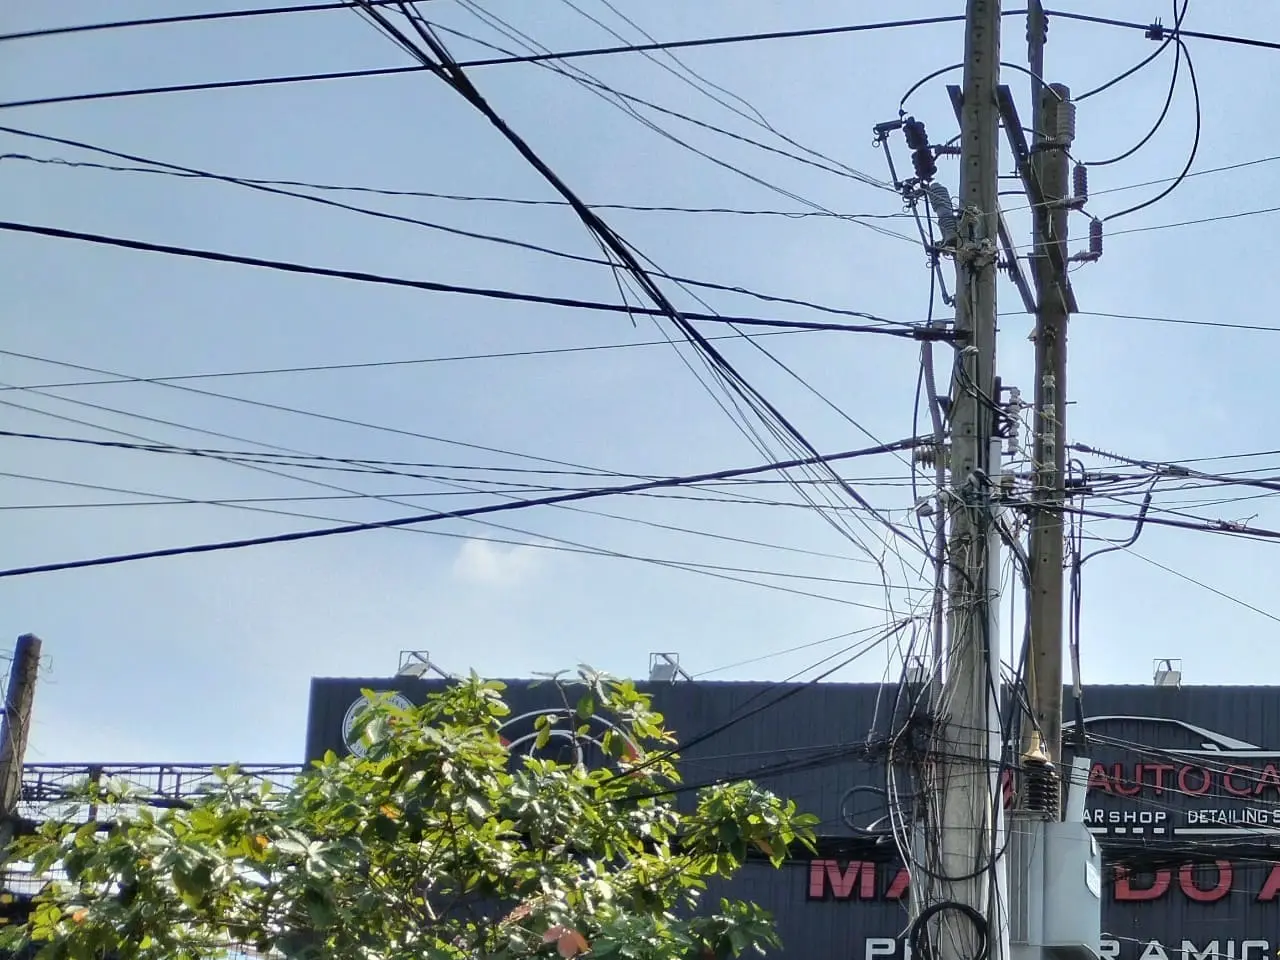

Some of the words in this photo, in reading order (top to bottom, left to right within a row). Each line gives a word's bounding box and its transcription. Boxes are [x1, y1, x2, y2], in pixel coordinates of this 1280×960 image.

[1088, 765, 1211, 796] AUTO
[1109, 811, 1166, 823] SHOP
[1188, 809, 1268, 823] DETAILING
